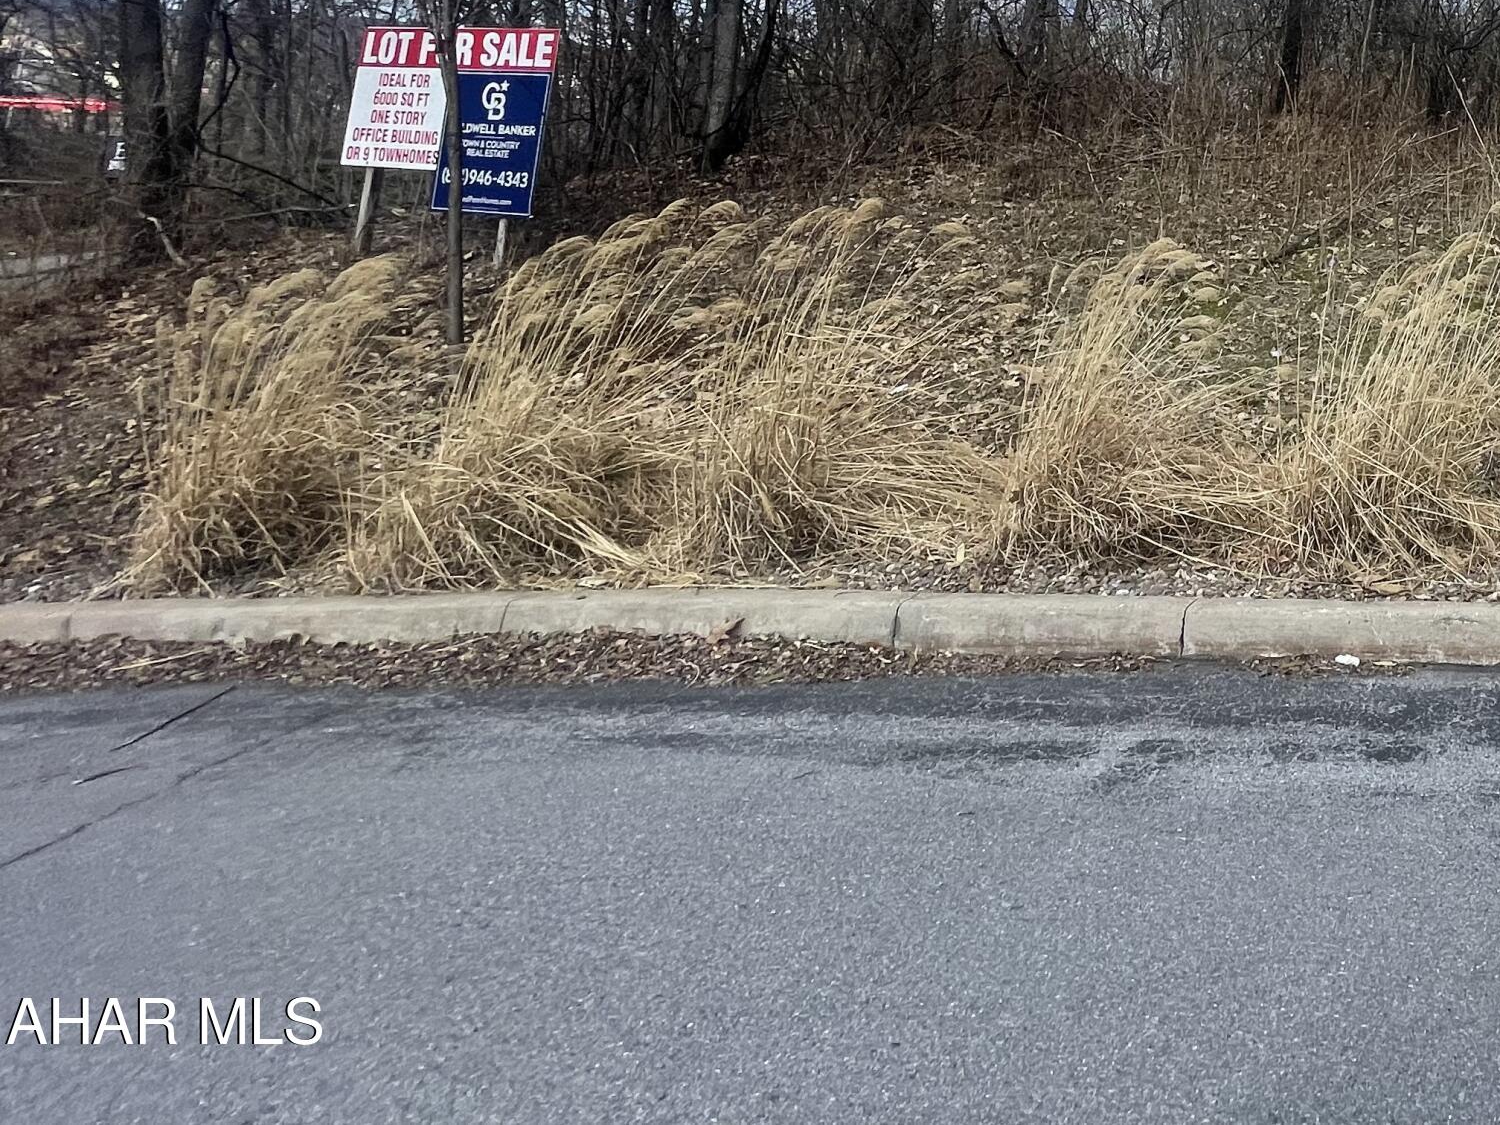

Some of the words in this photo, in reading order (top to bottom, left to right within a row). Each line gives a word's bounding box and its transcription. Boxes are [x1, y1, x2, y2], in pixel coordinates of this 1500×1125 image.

[362, 31, 415, 64] LOT
[419, 32, 475, 65] FR
[480, 33, 555, 68] SALE
[378, 73, 407, 88] IDEAL
[410, 74, 431, 88] FOR
[373, 91, 398, 106] 6000
[400, 92, 415, 106] SQ
[417, 93, 430, 106] FT
[370, 110, 390, 124] ONE
[393, 110, 427, 125] STORY
[353, 128, 388, 143] OFFICE
[391, 130, 438, 146] BUILDING
[461, 123, 496, 135] LDWELL
[498, 124, 536, 136] BANKER
[461, 139, 480, 148] OWN
[486, 140, 521, 150] COUNTRY
[346, 146, 360, 160] OR
[362, 147, 370, 161] 9
[373, 147, 439, 165] TOWNHOMES
[485, 149, 510, 159] ESTATE
